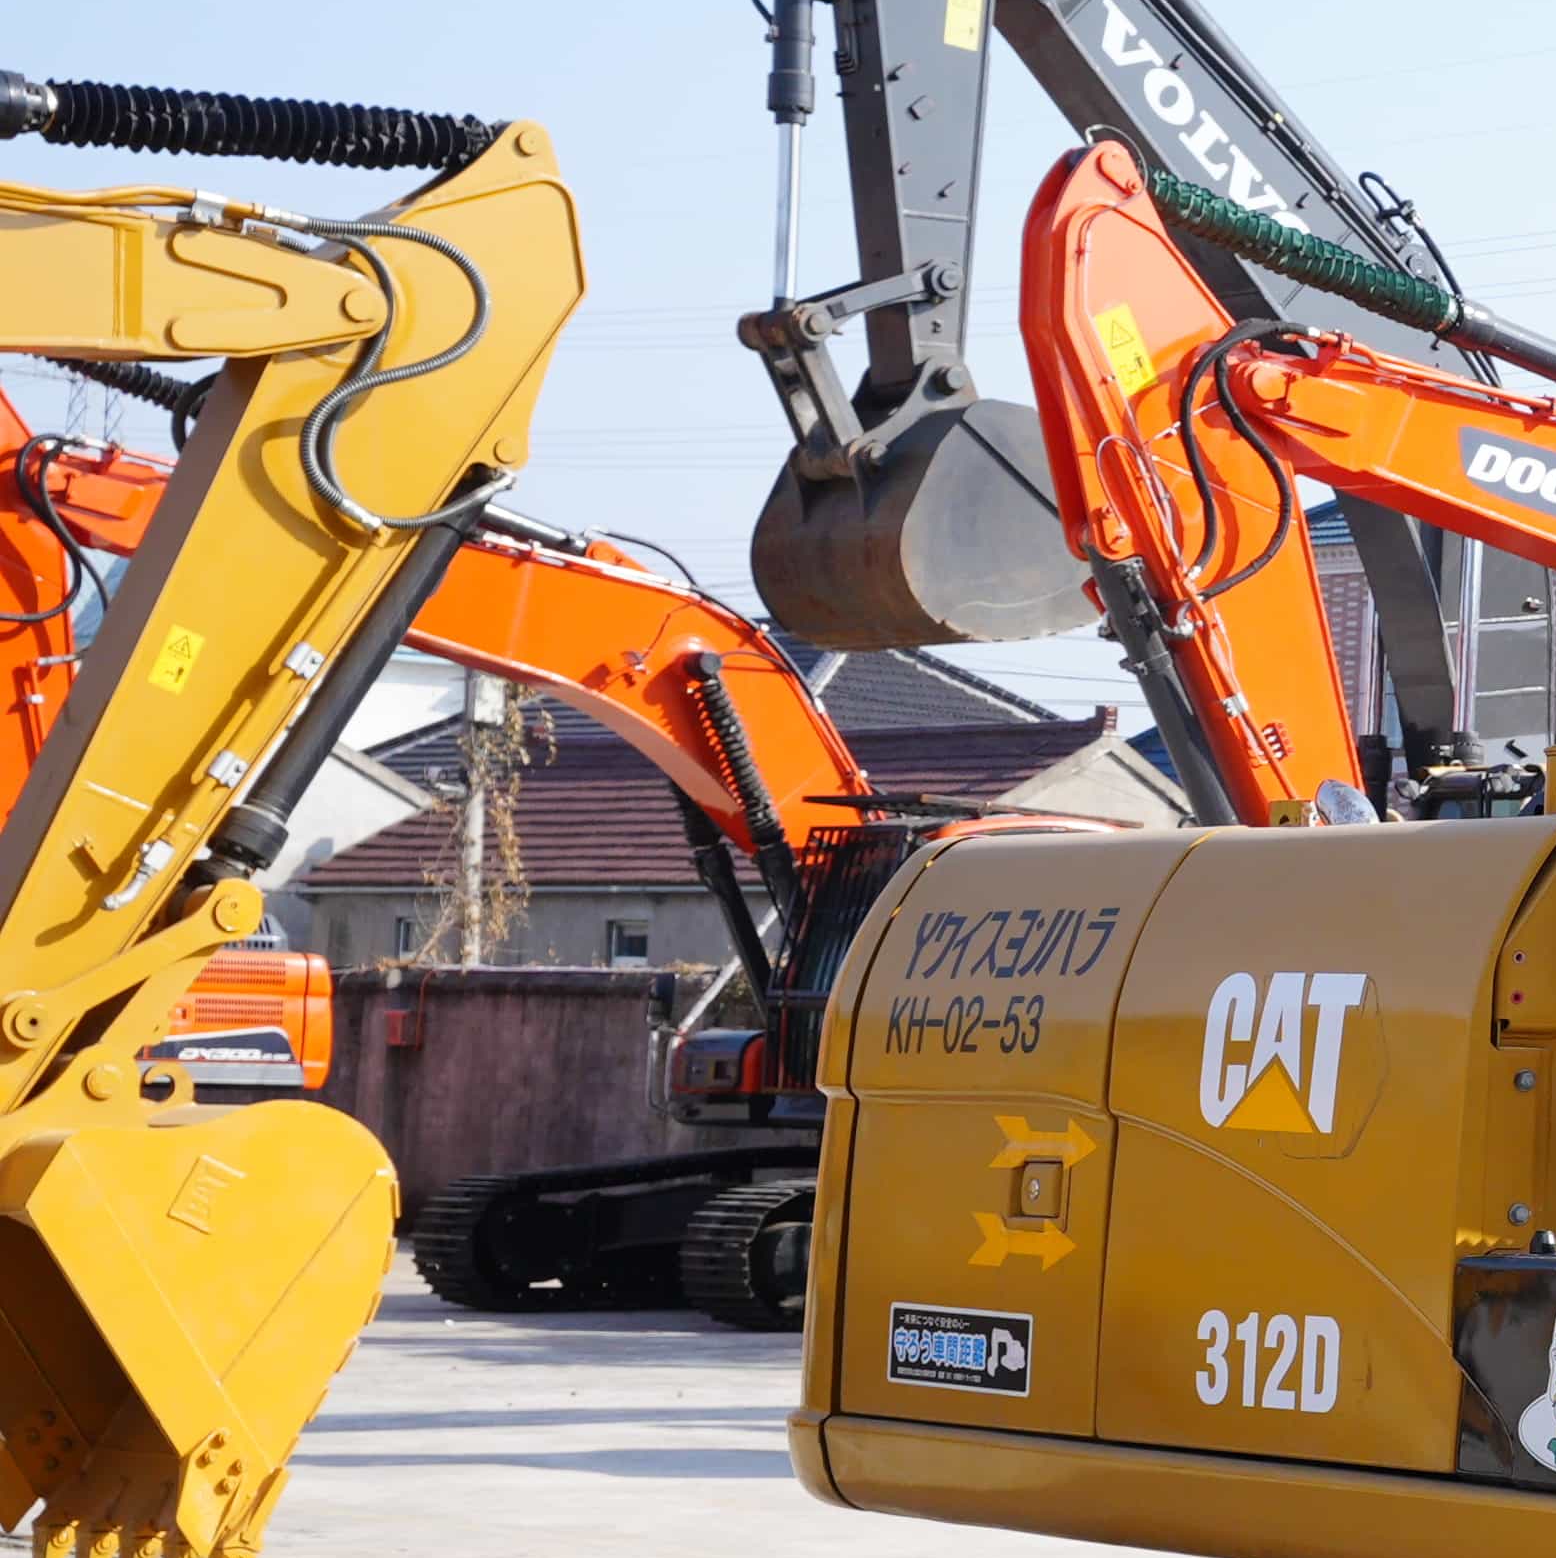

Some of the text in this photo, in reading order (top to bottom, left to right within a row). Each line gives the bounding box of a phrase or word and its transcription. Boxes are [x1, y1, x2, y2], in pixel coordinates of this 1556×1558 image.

[886, 995, 1045, 1054] KH-02-53
[1199, 972, 1370, 1135] CAT
[1195, 1308, 1341, 1414] 312D
